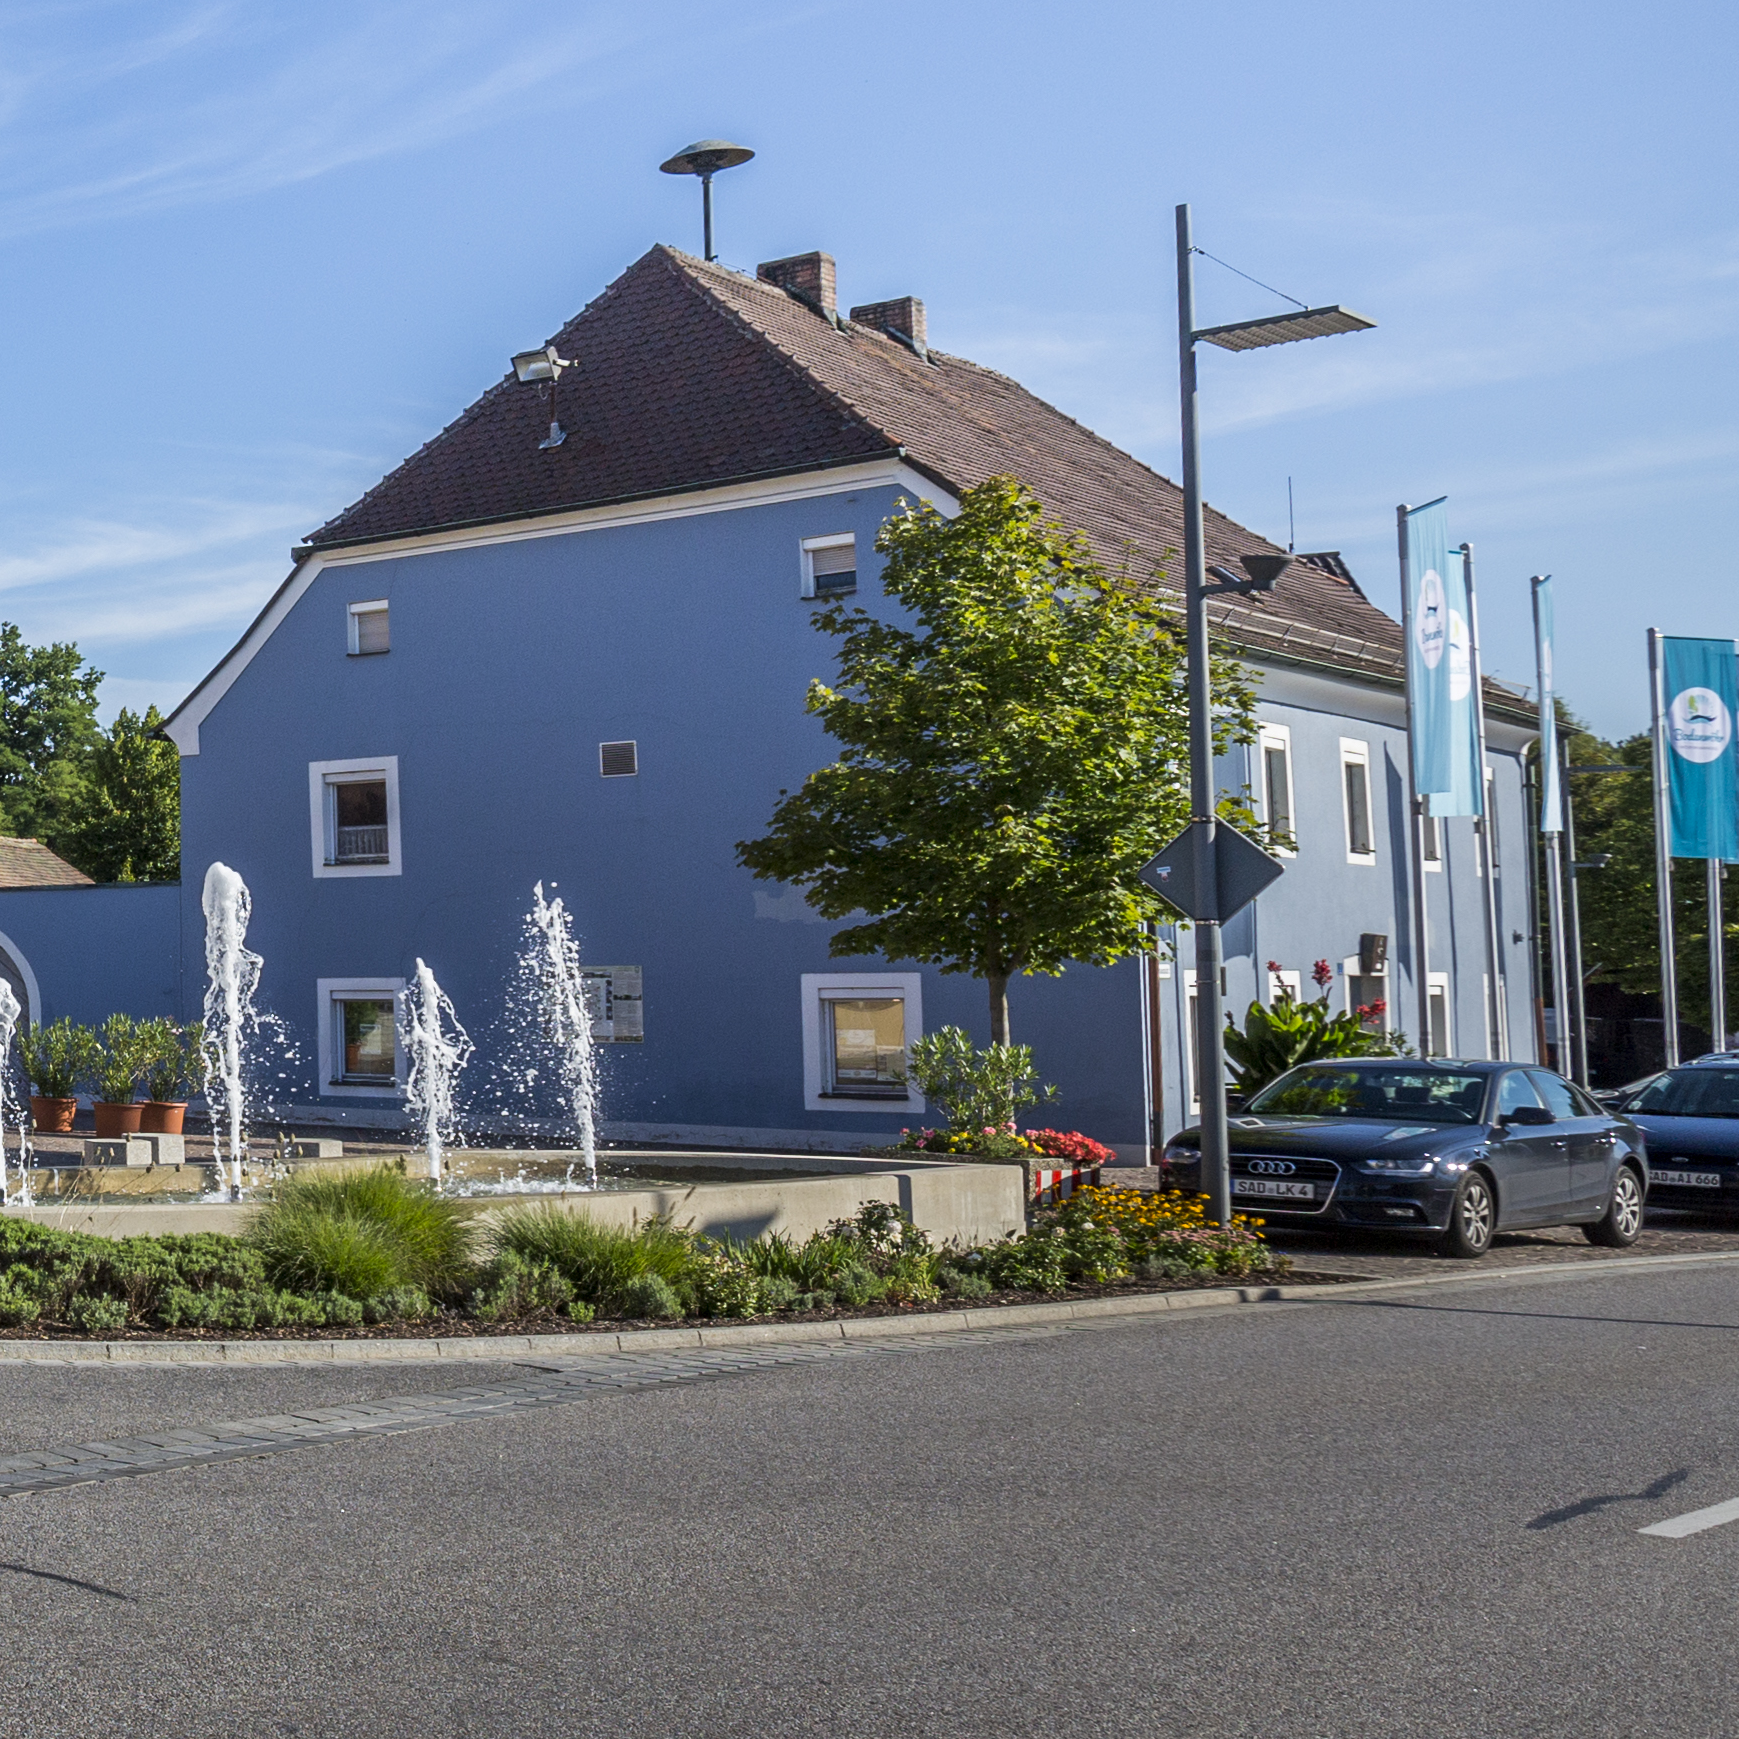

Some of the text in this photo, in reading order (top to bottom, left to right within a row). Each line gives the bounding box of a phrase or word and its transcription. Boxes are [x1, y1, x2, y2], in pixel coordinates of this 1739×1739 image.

[1695, 1175, 1719, 1186] 666
[1238, 1181, 1308, 1197] SAD LK 4
